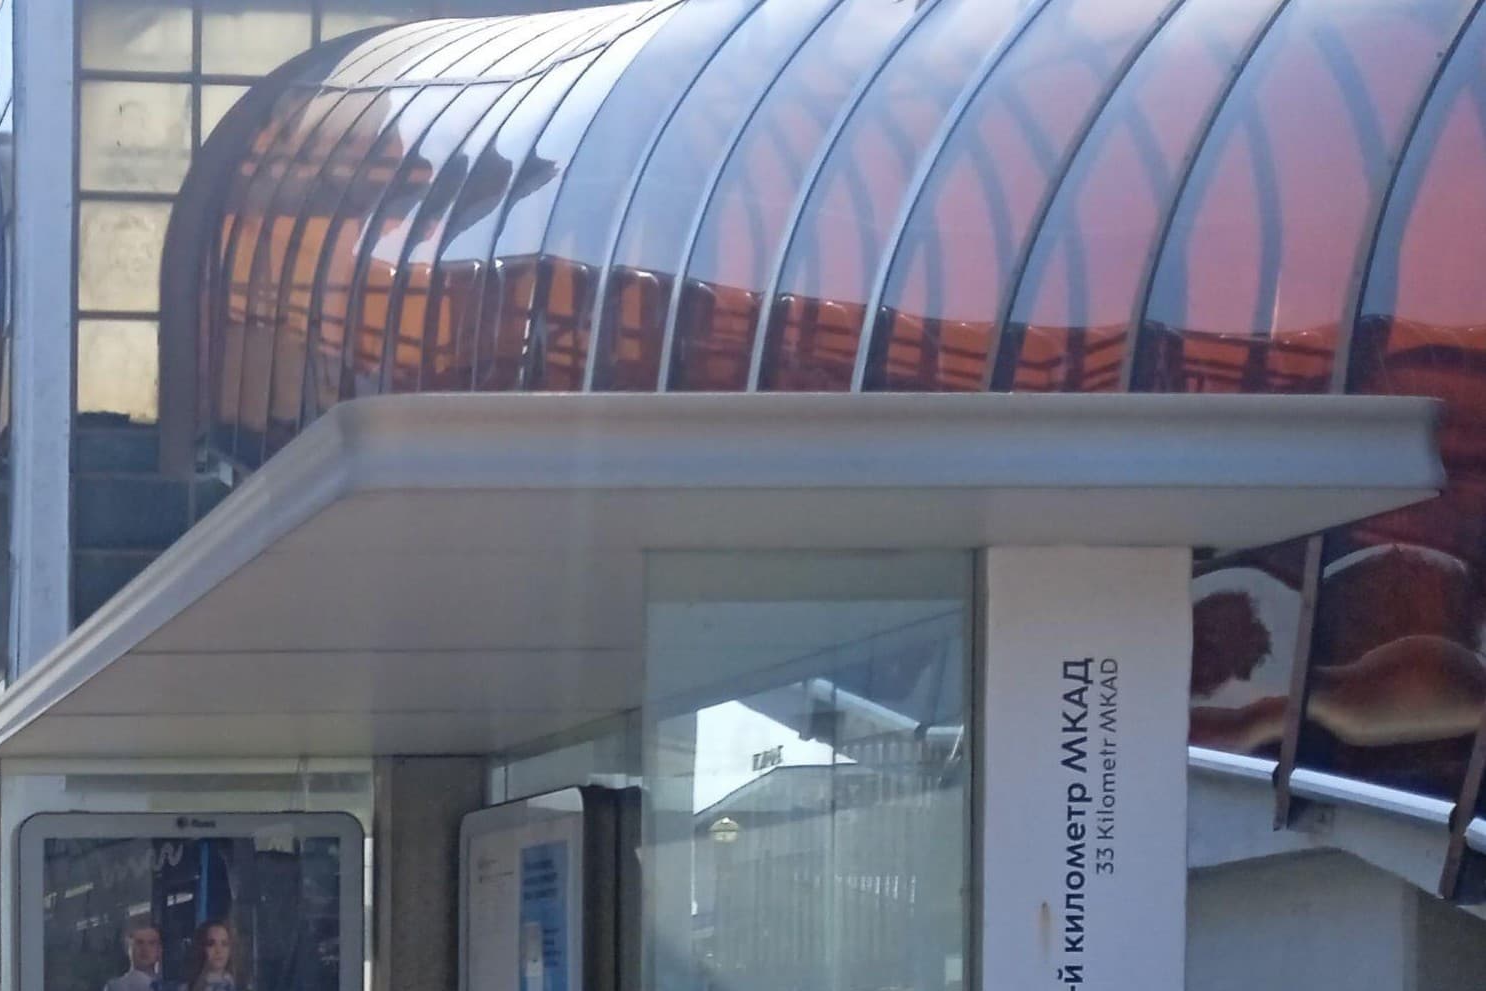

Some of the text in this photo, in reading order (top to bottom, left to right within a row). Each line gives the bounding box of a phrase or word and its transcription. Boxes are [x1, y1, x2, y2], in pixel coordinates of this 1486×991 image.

[1059, 657, 1095, 773] МКАД
[1095, 657, 1119, 875] 33 Kilometr MKAD
[1063, 782, 1093, 952] километр
